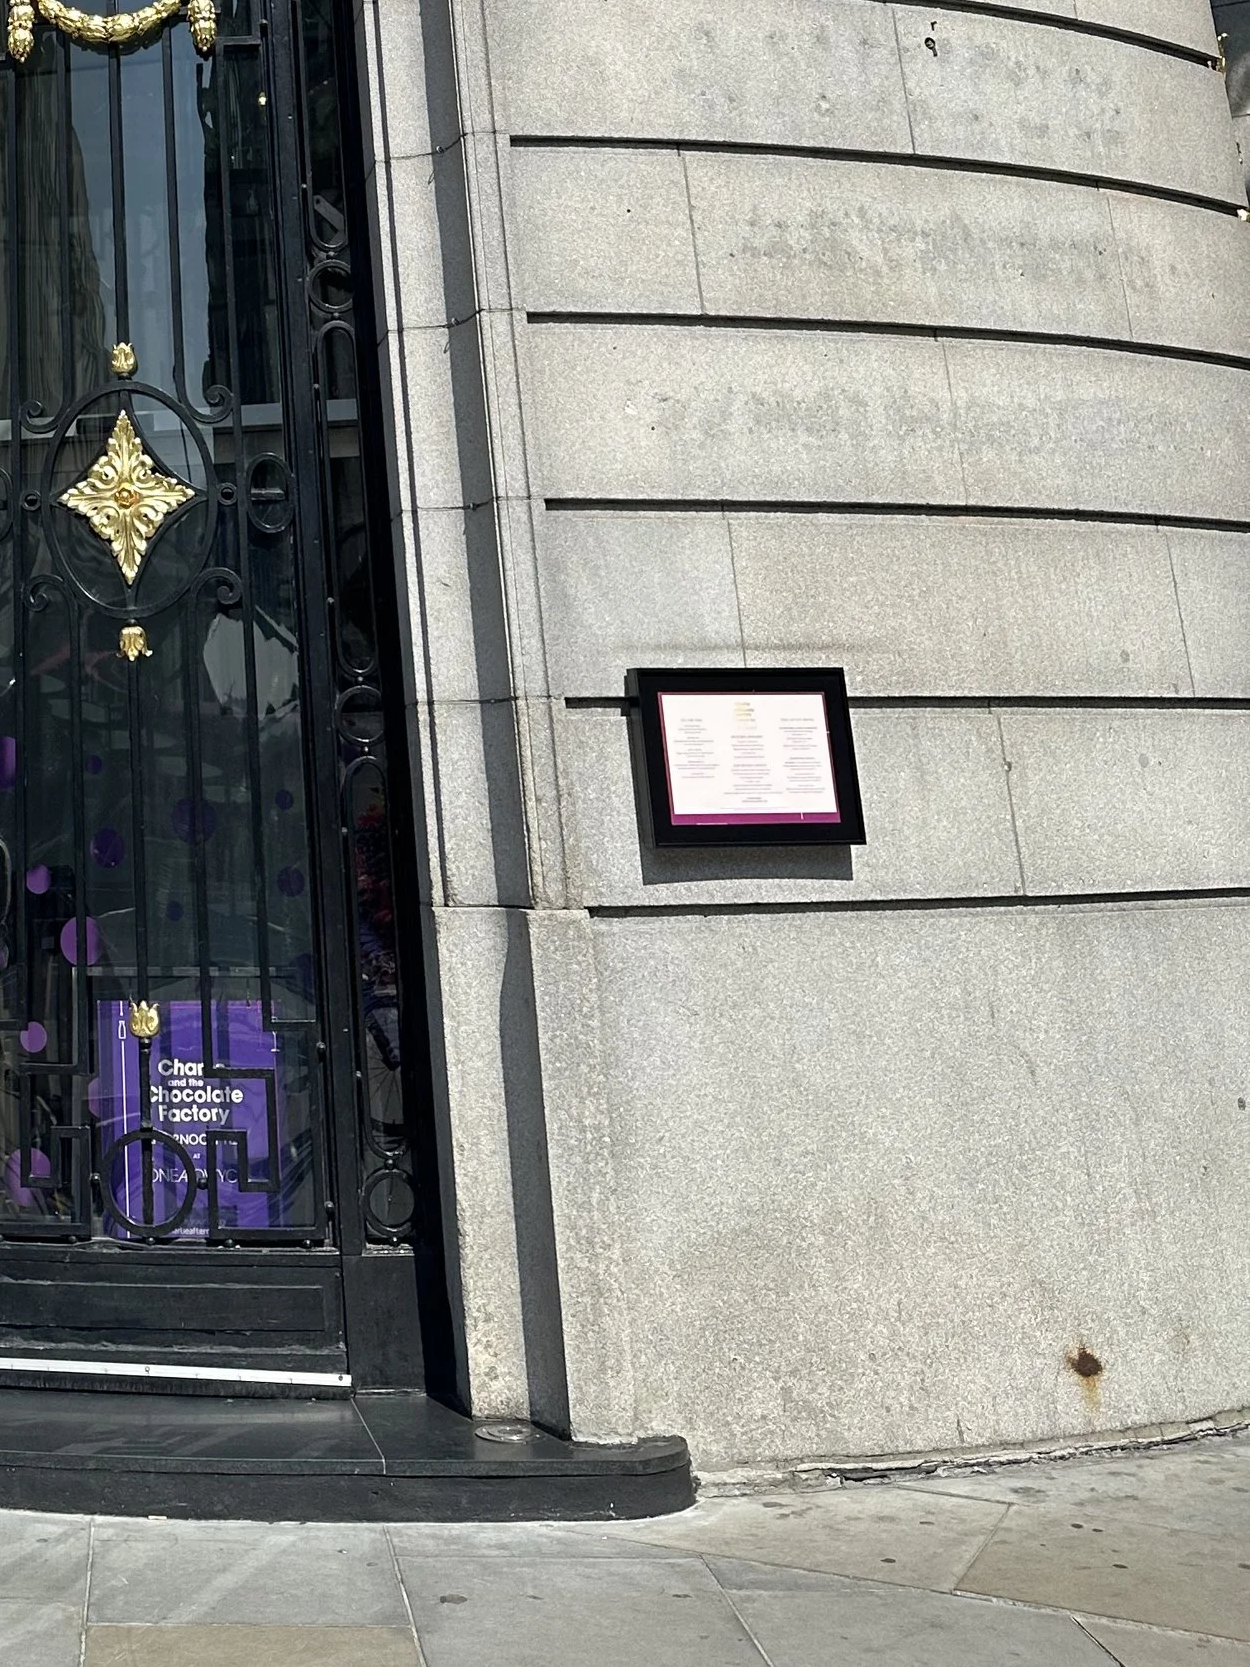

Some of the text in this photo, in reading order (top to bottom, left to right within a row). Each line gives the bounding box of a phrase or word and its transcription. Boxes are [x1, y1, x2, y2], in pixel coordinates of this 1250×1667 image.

[167, 1078, 204, 1087] and the
[150, 1085, 244, 1103] Chocolate
[158, 1104, 230, 1126] Factory
